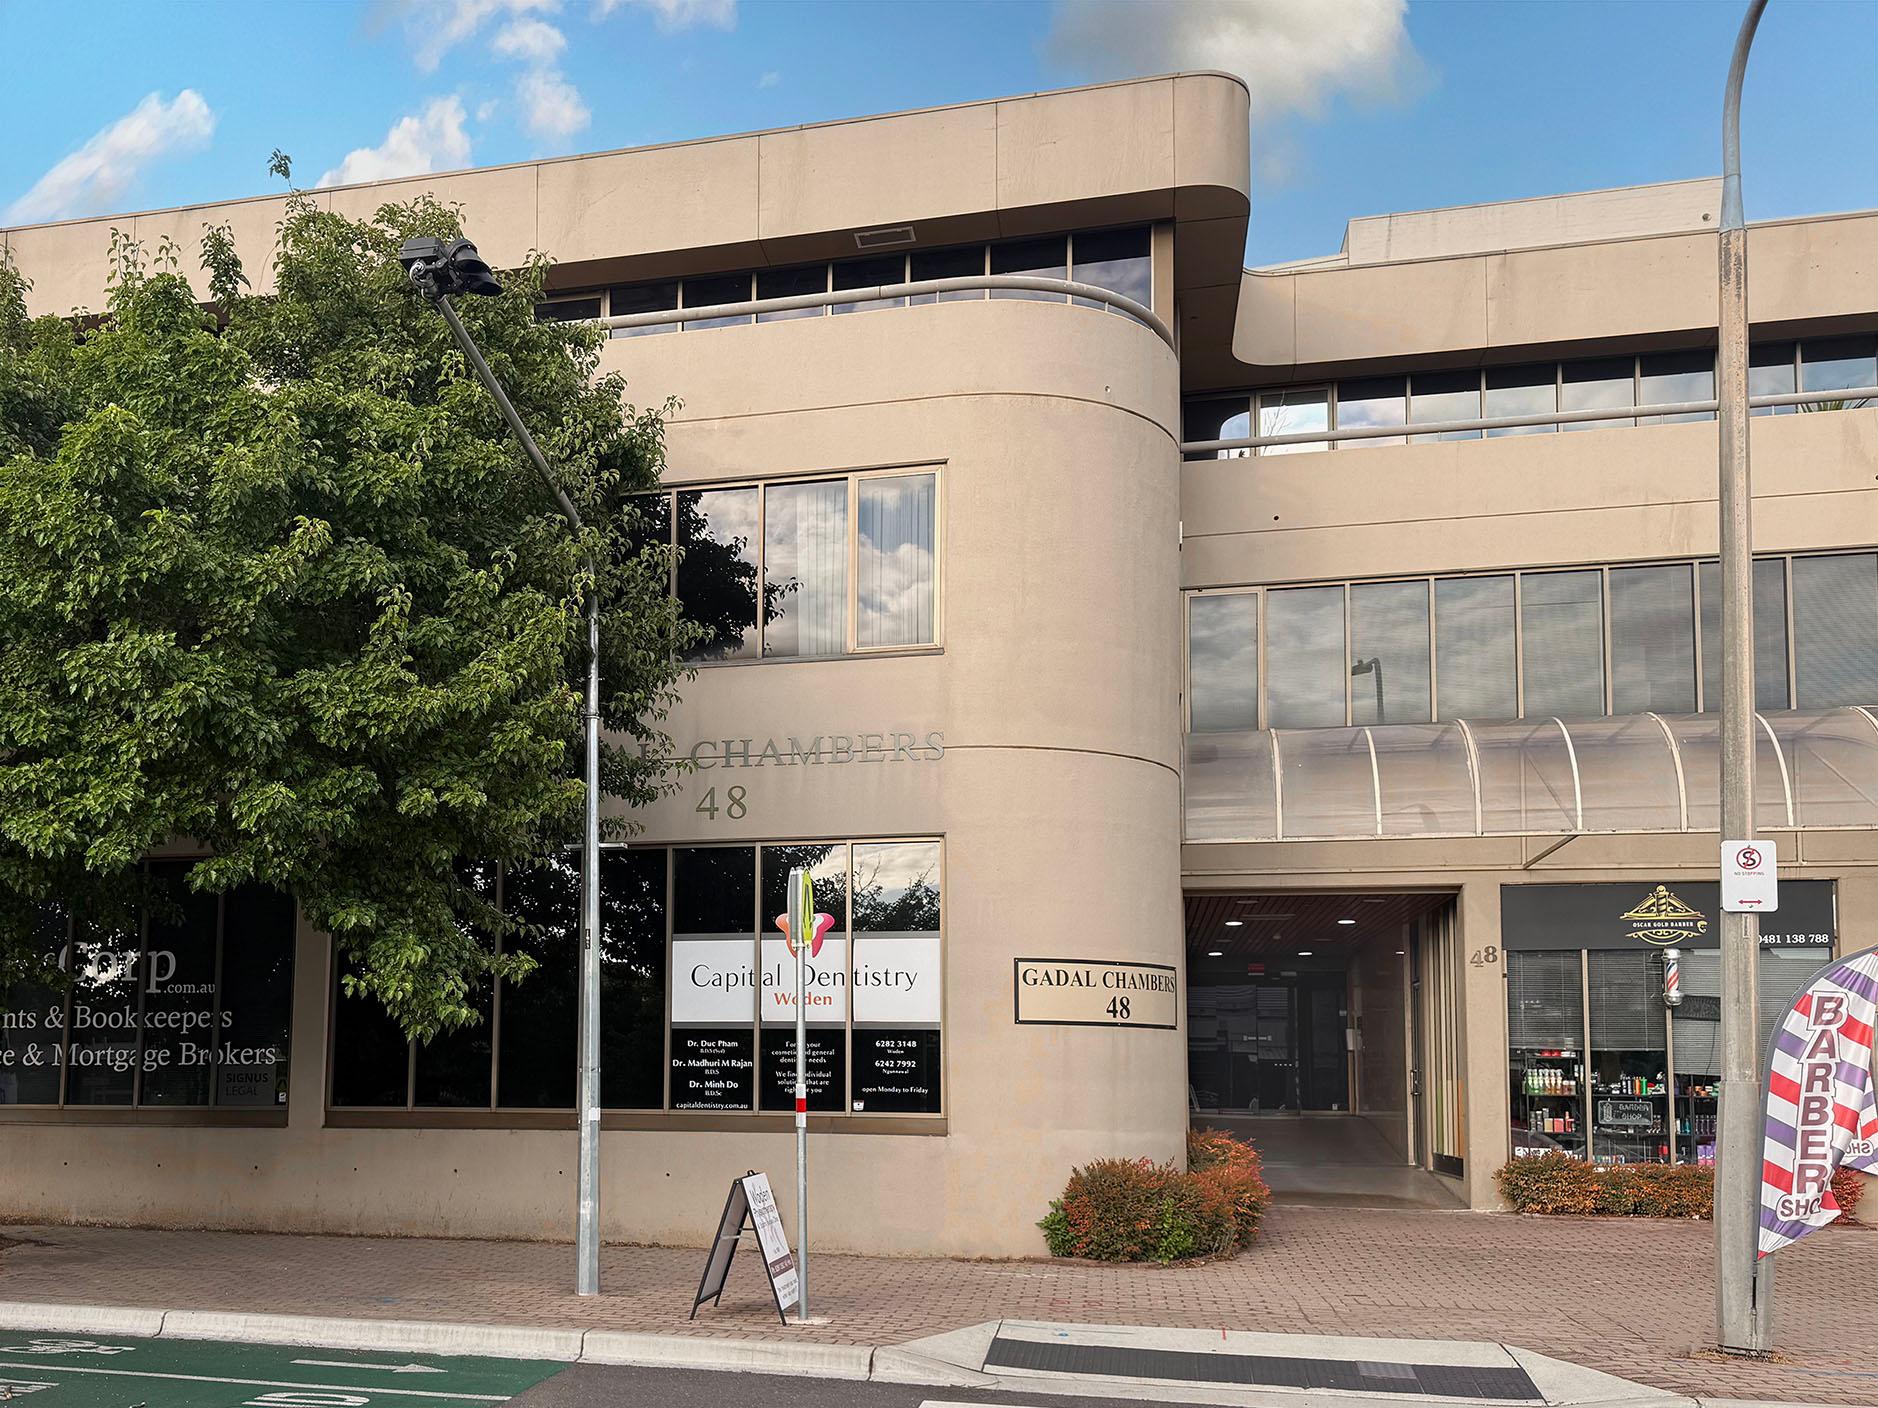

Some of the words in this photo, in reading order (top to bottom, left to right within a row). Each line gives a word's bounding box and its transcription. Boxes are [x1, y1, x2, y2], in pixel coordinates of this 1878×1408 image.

[690, 730, 946, 771] CHAMBERS
[695, 785, 748, 821] 48
[1785, 934, 1806, 944] 138
[1808, 934, 1829, 944] 788
[1470, 945, 1498, 968] 48
[690, 963, 781, 993] Capital
[803, 963, 918, 992] Dentistry
[1022, 968, 1097, 988] GADAL
[1102, 971, 1175, 993] CHAMBERS
[774, 992, 833, 1006] Woden
[1106, 995, 1131, 1020] 48
[44, 1006, 64, 1029] &
[73, 1005, 233, 1034] Bookkeepes
[875, 1040, 895, 1048] 6282
[897, 1040, 917, 1048] 3148
[0, 1049, 15, 1067] e
[22, 1042, 44, 1067] &
[672, 1059, 686, 1067] Dr.
[687, 1059, 720, 1067] Madhuri
[721, 1059, 730, 1067] M
[731, 1059, 753, 1069] Rajan
[874, 1060, 895, 1068] 6242
[896, 1060, 917, 1068] 7992
[225, 1072, 268, 1084] SIGNUS
[689, 1080, 703, 1088] Dr.
[704, 1080, 725, 1088] Minh
[726, 1080, 739, 1088] Do
[878, 1086, 901, 1094] Monday
[910, 1087, 929, 1095] Friday
[1796, 995, 1845, 1194] BARBER
[676, 1102, 748, 1110] capitaldentistry.com.au
